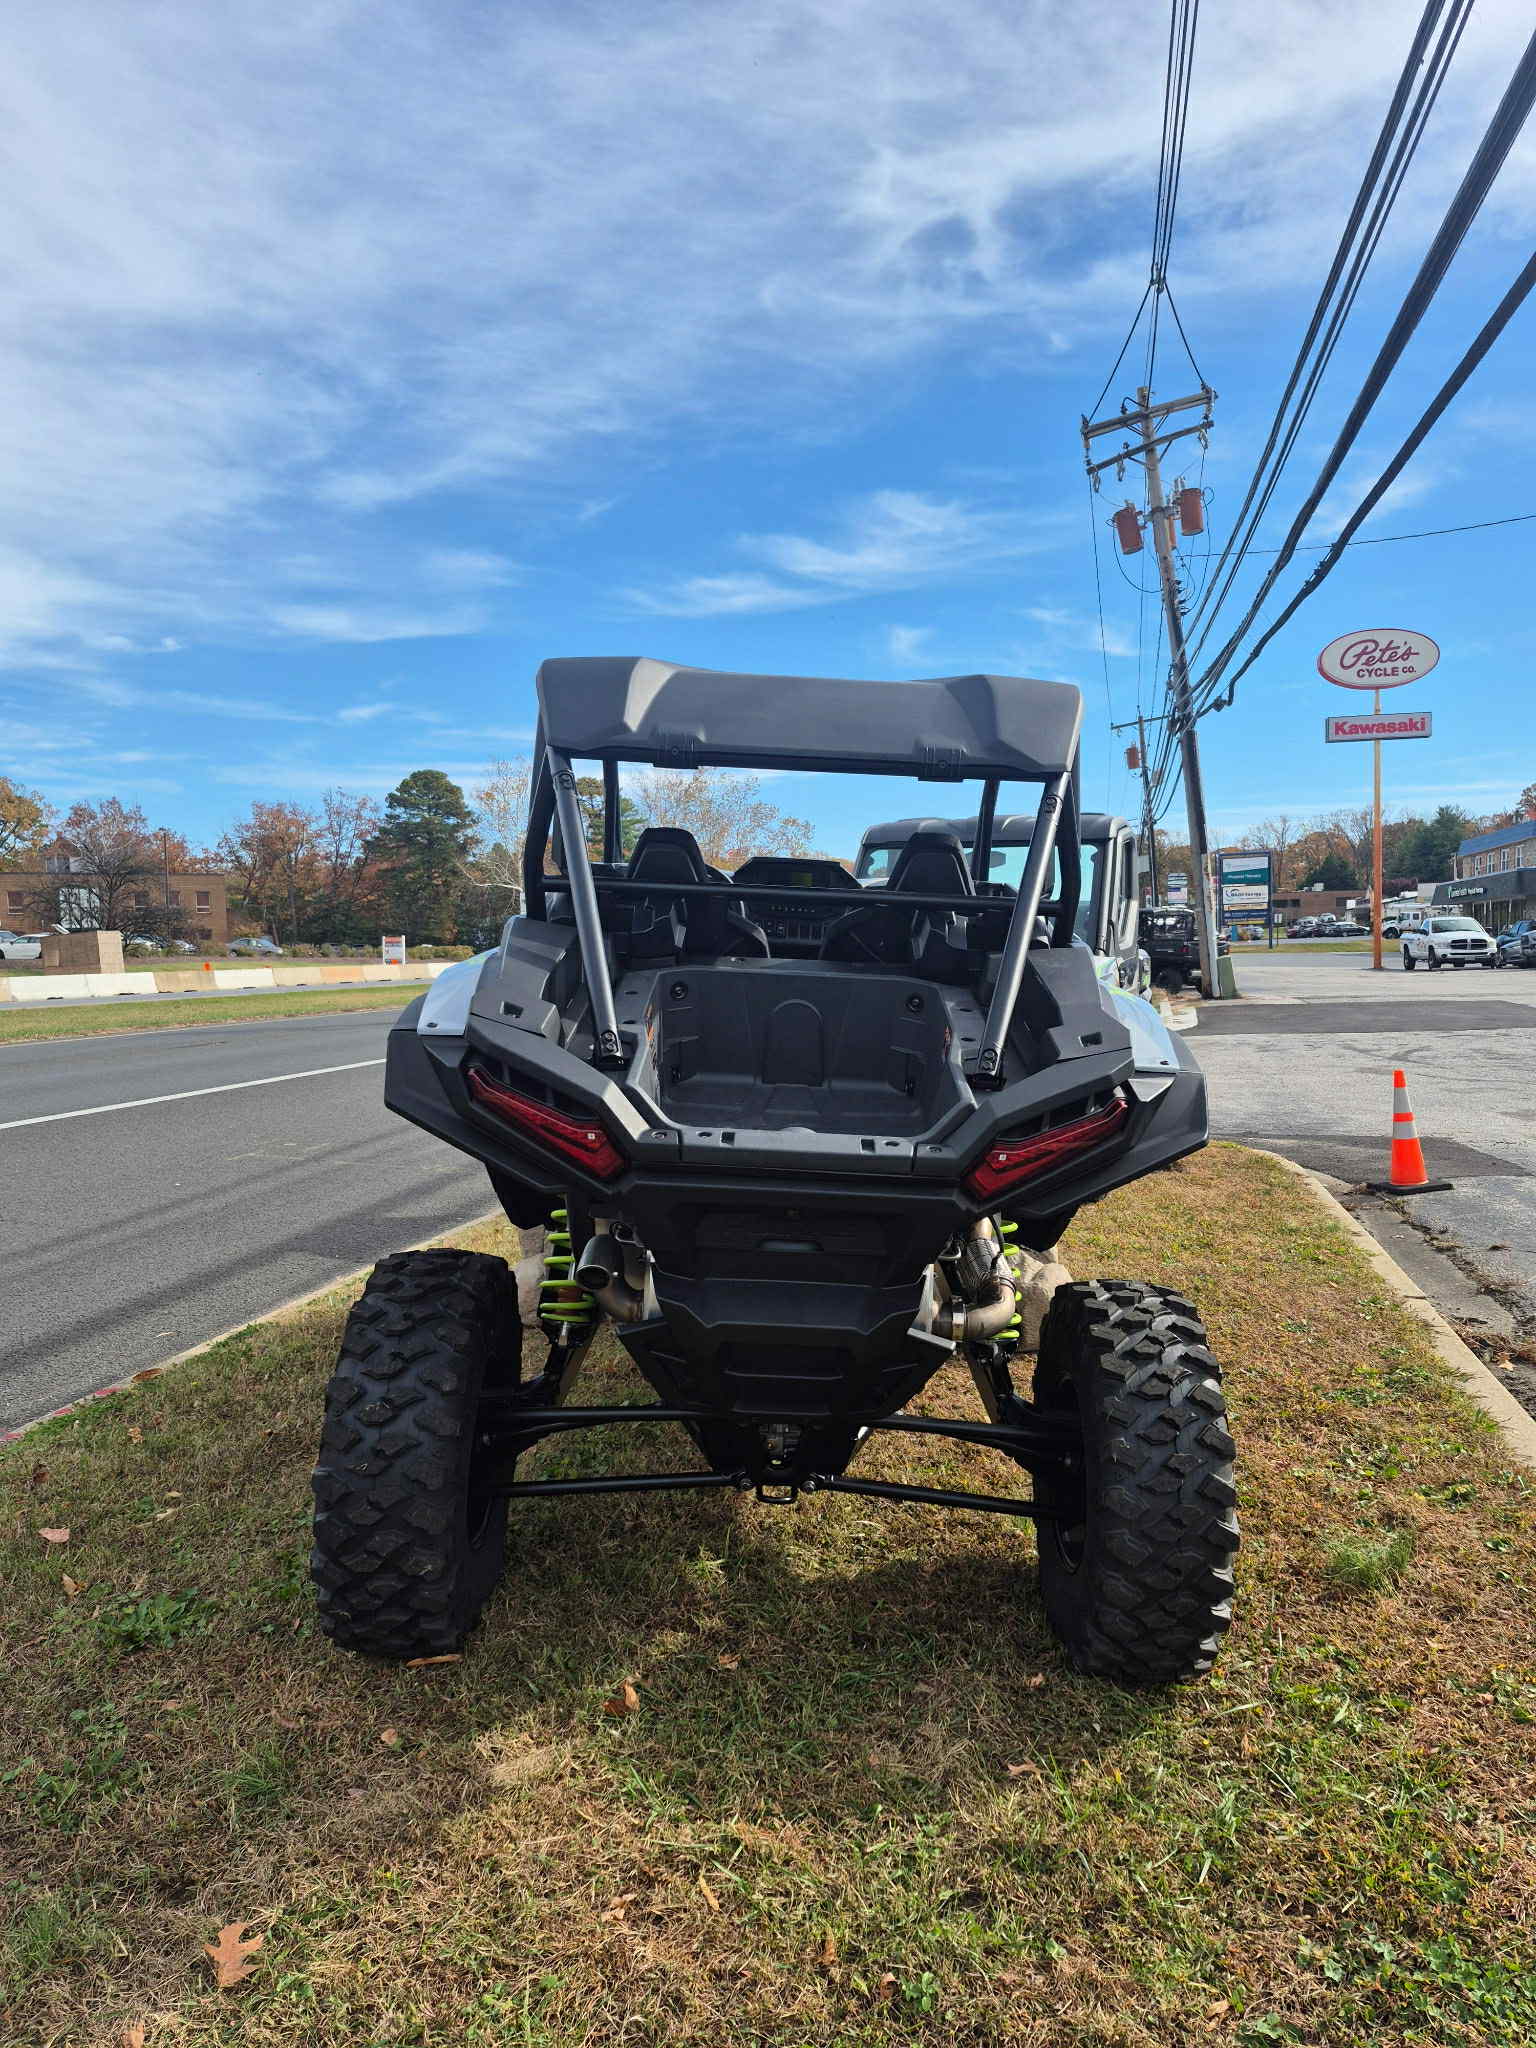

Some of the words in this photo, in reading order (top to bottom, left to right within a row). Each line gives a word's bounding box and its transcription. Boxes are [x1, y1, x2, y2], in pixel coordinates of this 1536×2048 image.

[1340, 639, 1420, 670] Pete's
[1356, 667, 1399, 678] CYCLE
[1401, 665, 1417, 674] CO.
[1334, 717, 1426, 736] Kawasaki
